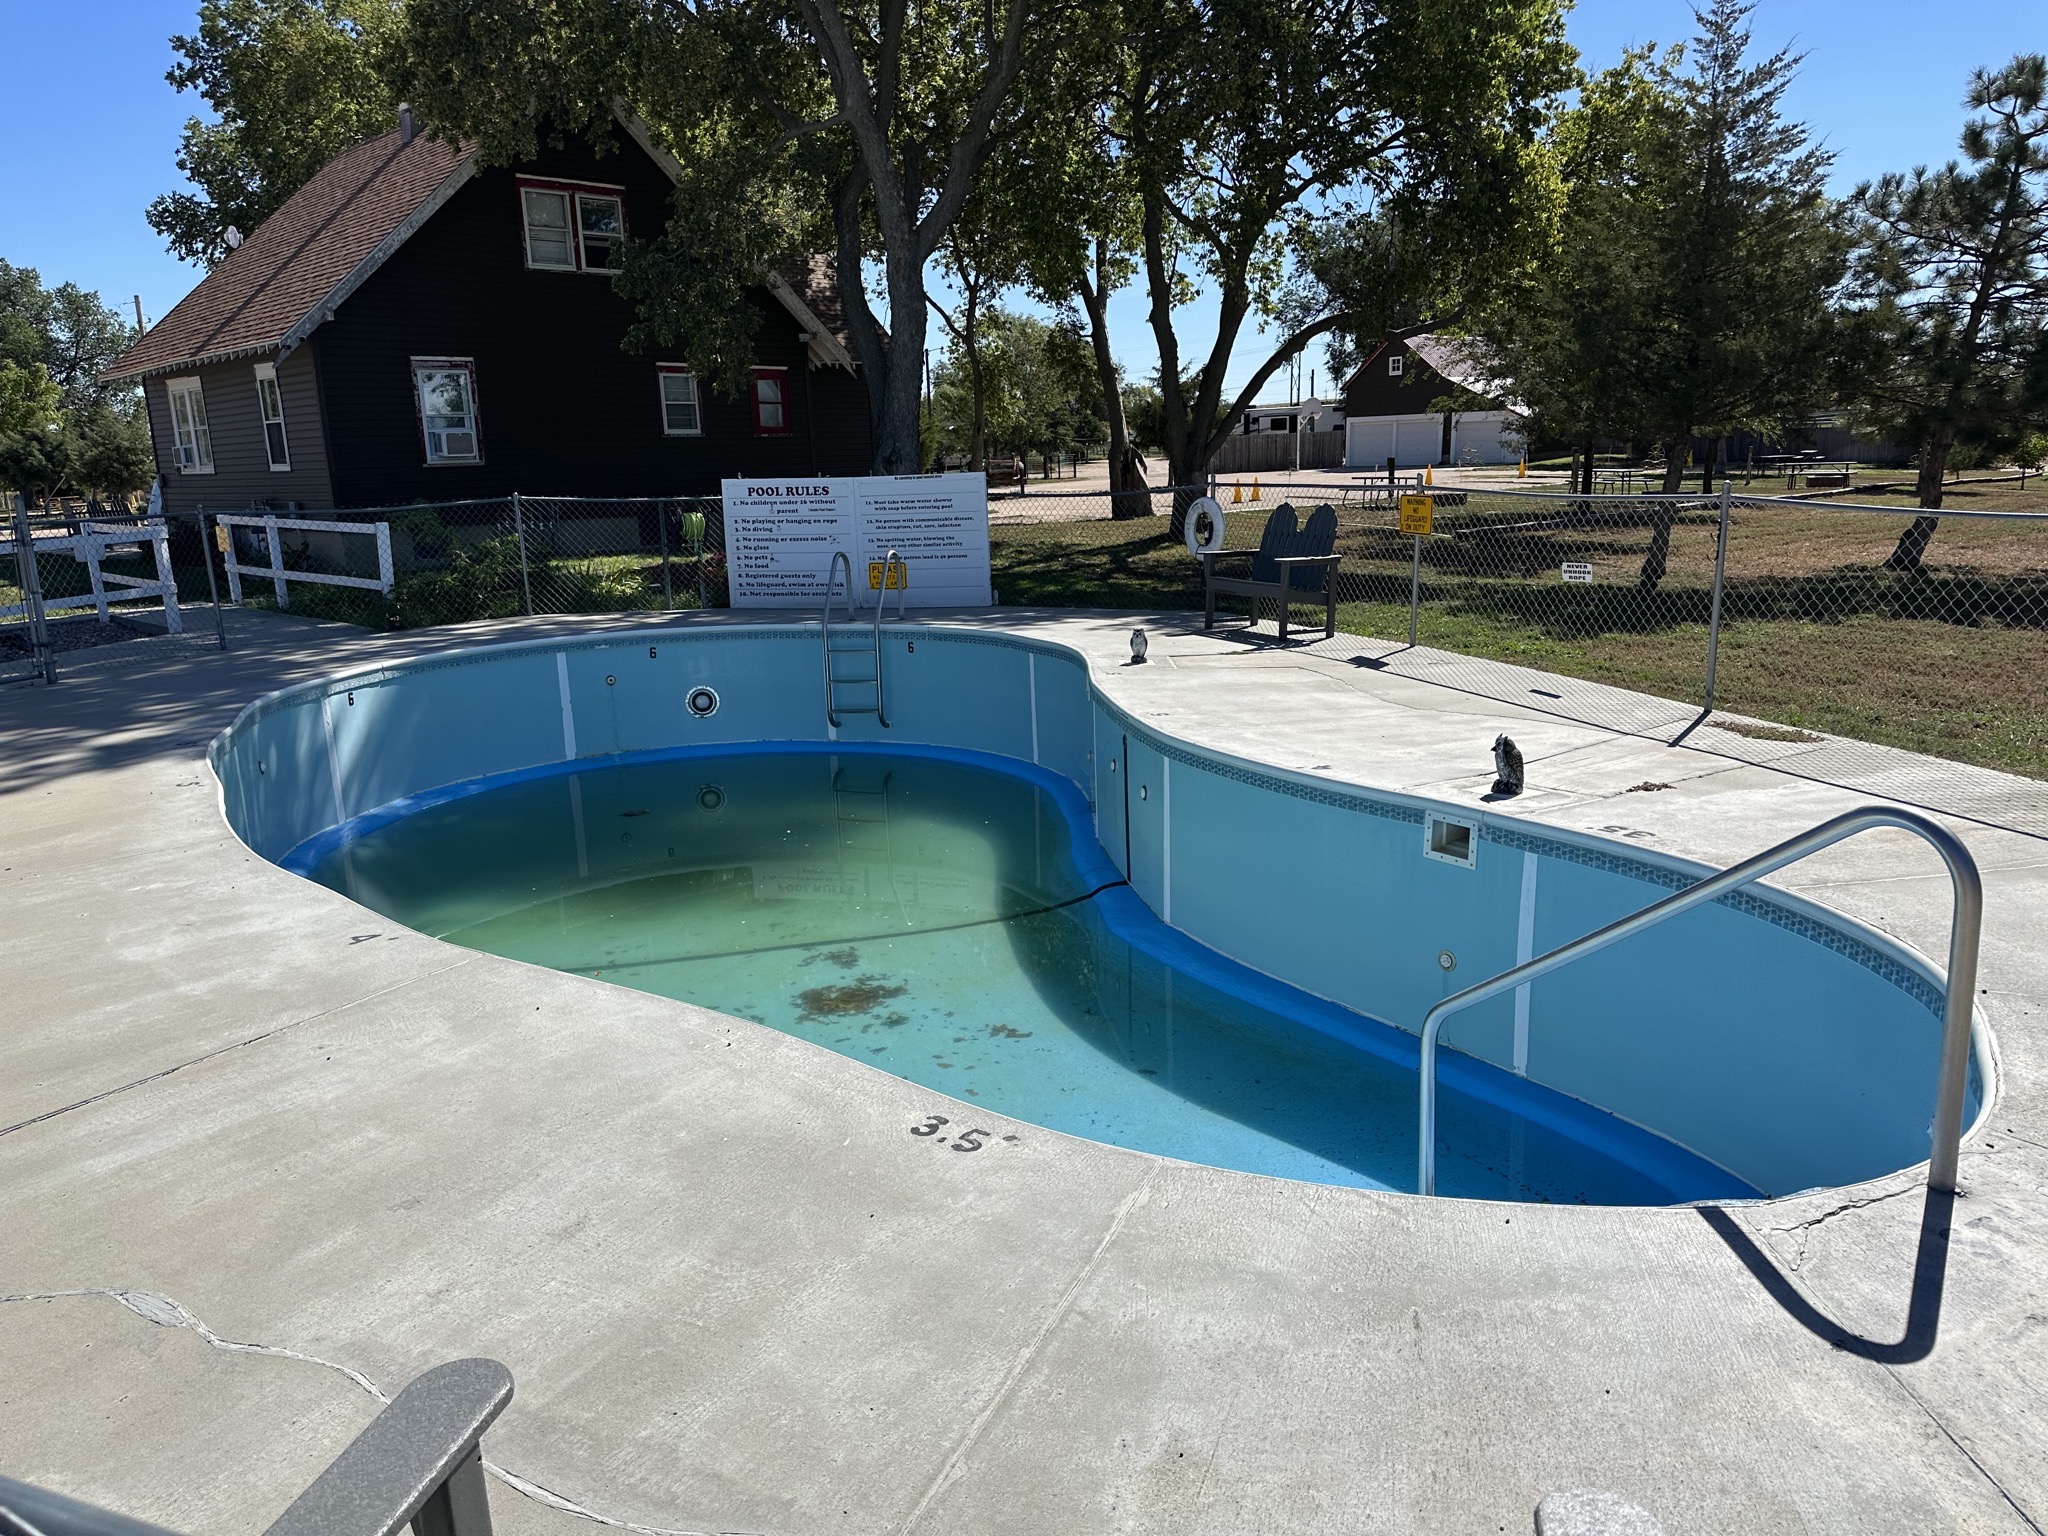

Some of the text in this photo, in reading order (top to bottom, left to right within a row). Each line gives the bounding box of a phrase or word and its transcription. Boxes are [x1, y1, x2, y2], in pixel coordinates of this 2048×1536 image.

[747, 486, 830, 496] POOL RULES
[1406, 498, 1426, 506] WARNING
[1404, 514, 1428, 523] LIFEGUARD
[650, 646, 656, 658] 6
[908, 642, 914, 653] 6
[348, 692, 354, 706] 6
